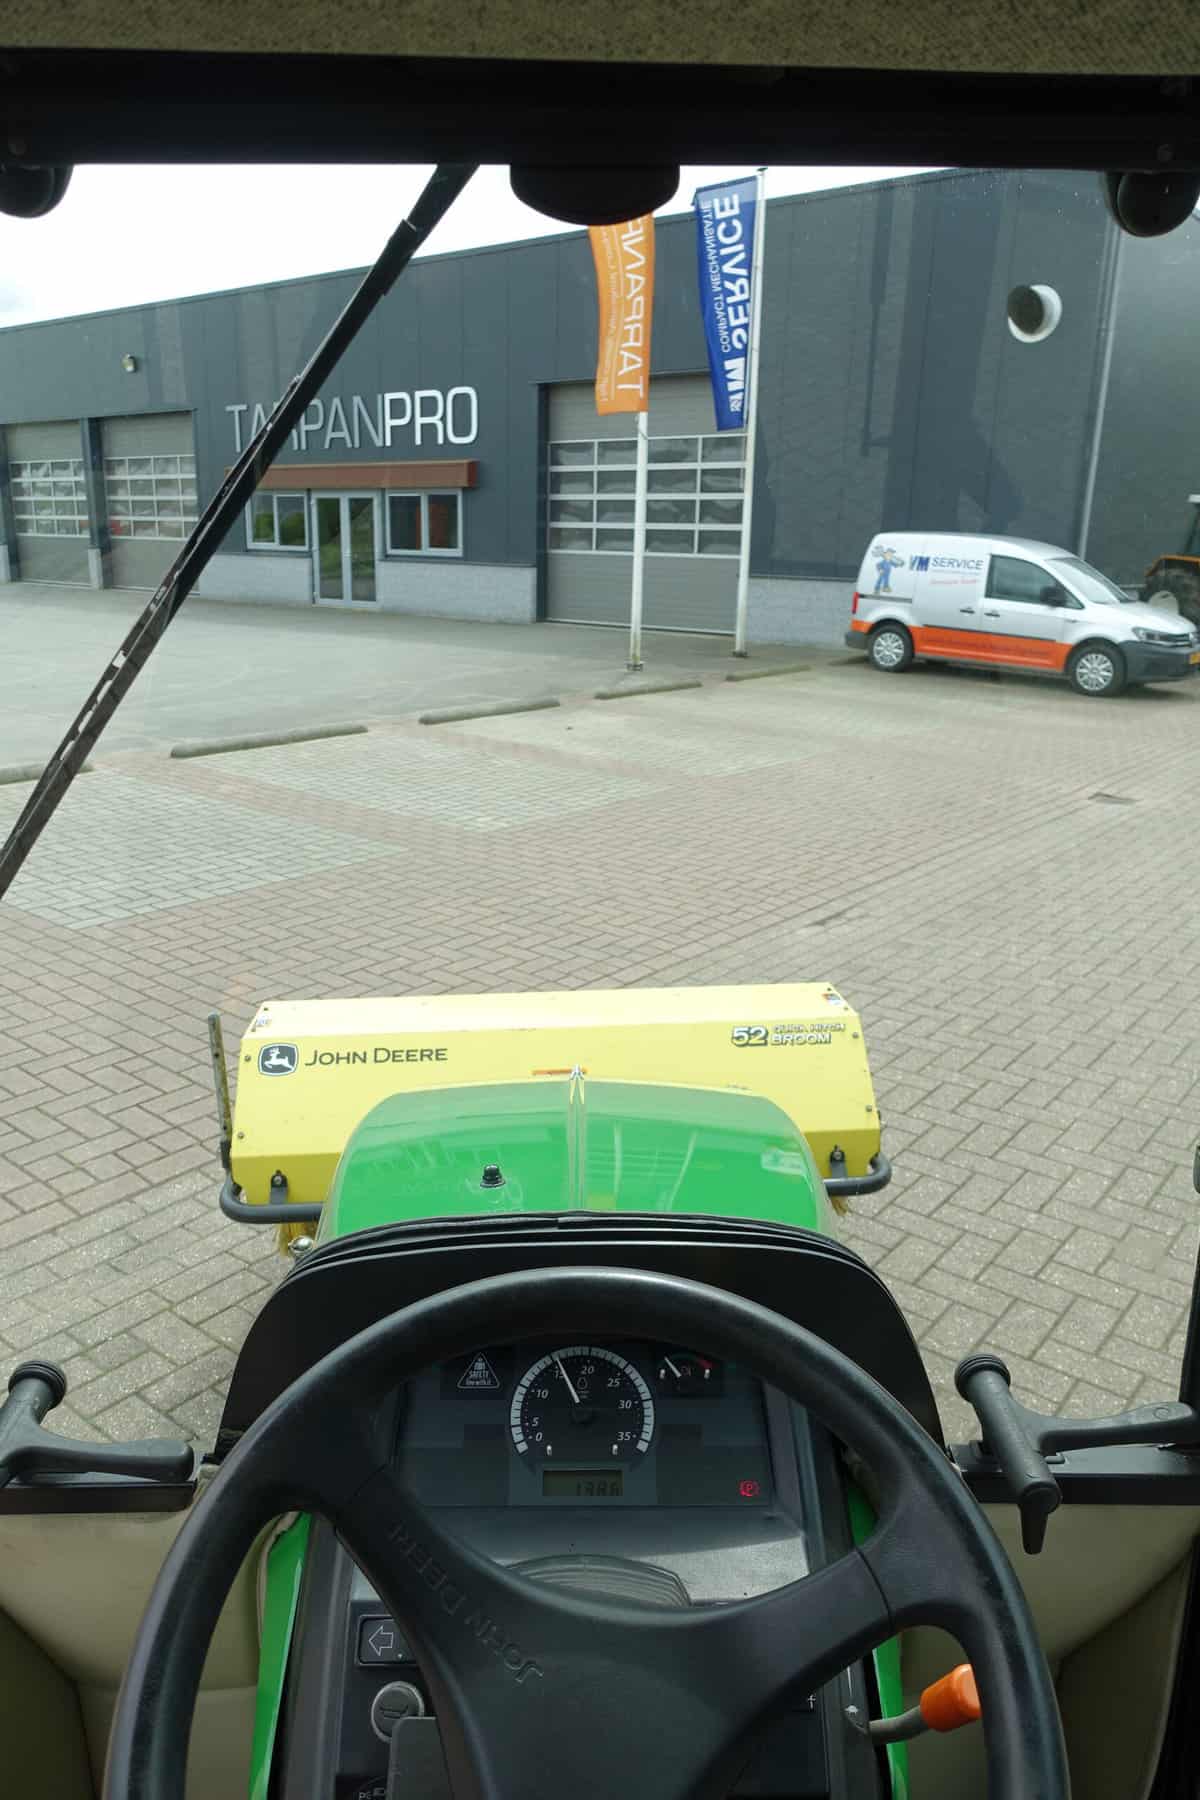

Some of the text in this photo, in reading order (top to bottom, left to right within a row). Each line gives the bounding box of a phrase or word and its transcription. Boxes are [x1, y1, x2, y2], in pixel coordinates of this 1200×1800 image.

[931, 557, 984, 570] SERVICE
[731, 1026, 769, 1047] 52
[771, 1032, 833, 1047] BROOM
[305, 1047, 449, 1067] JOHN DEERE
[580, 1365, 596, 1375] 20
[607, 1377, 622, 1388] 25
[535, 1389, 549, 1399] 10
[618, 1400, 632, 1409] 30
[531, 1417, 540, 1427] 5
[535, 1432, 543, 1442] 0
[617, 1431, 632, 1441] 35
